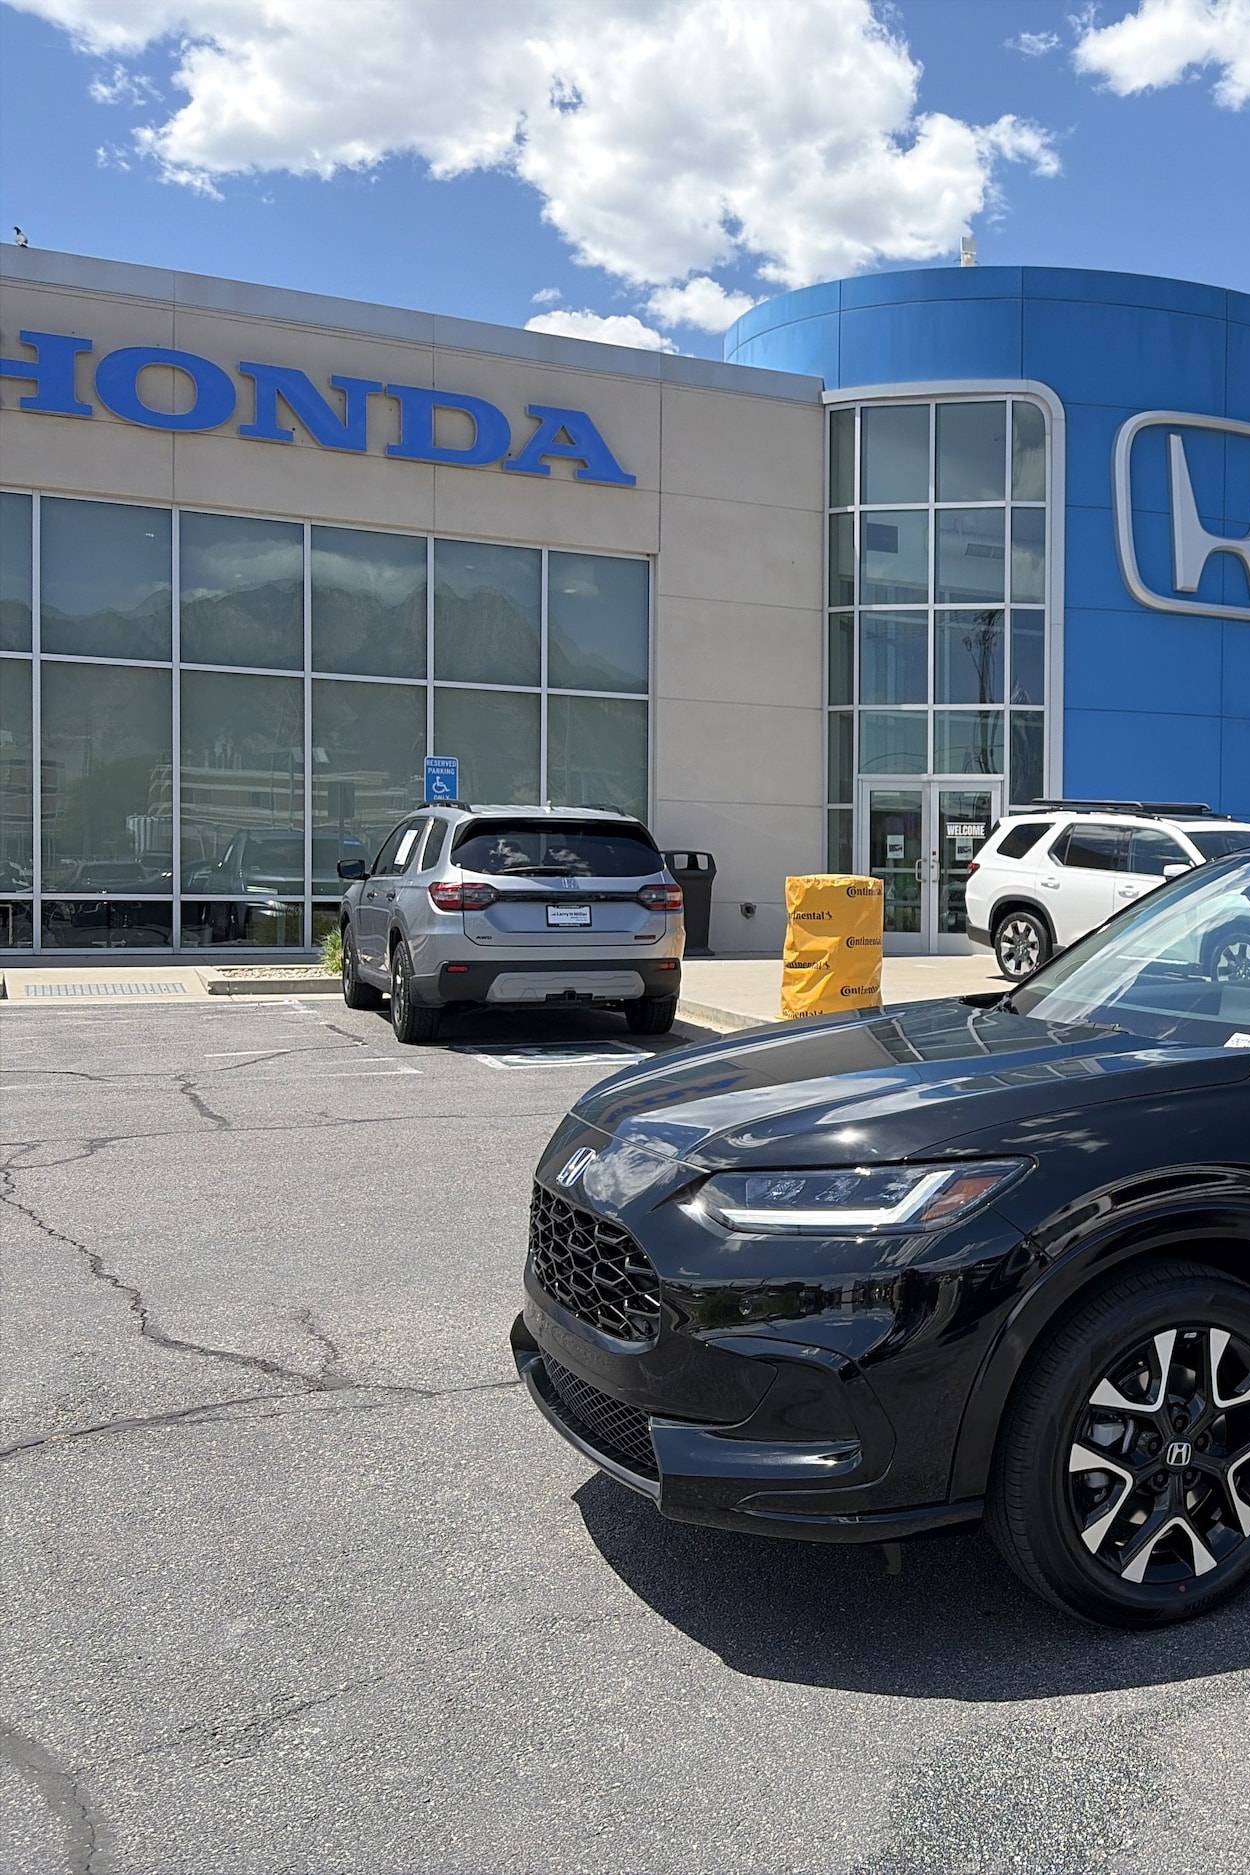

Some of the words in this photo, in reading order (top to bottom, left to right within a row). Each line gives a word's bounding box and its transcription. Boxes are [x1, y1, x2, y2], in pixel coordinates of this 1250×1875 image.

[0, 329, 637, 487] HONDA
[426, 759, 457, 767] RESERVED
[427, 767, 455, 775] PARKING
[946, 824, 985, 836] WELCOME
